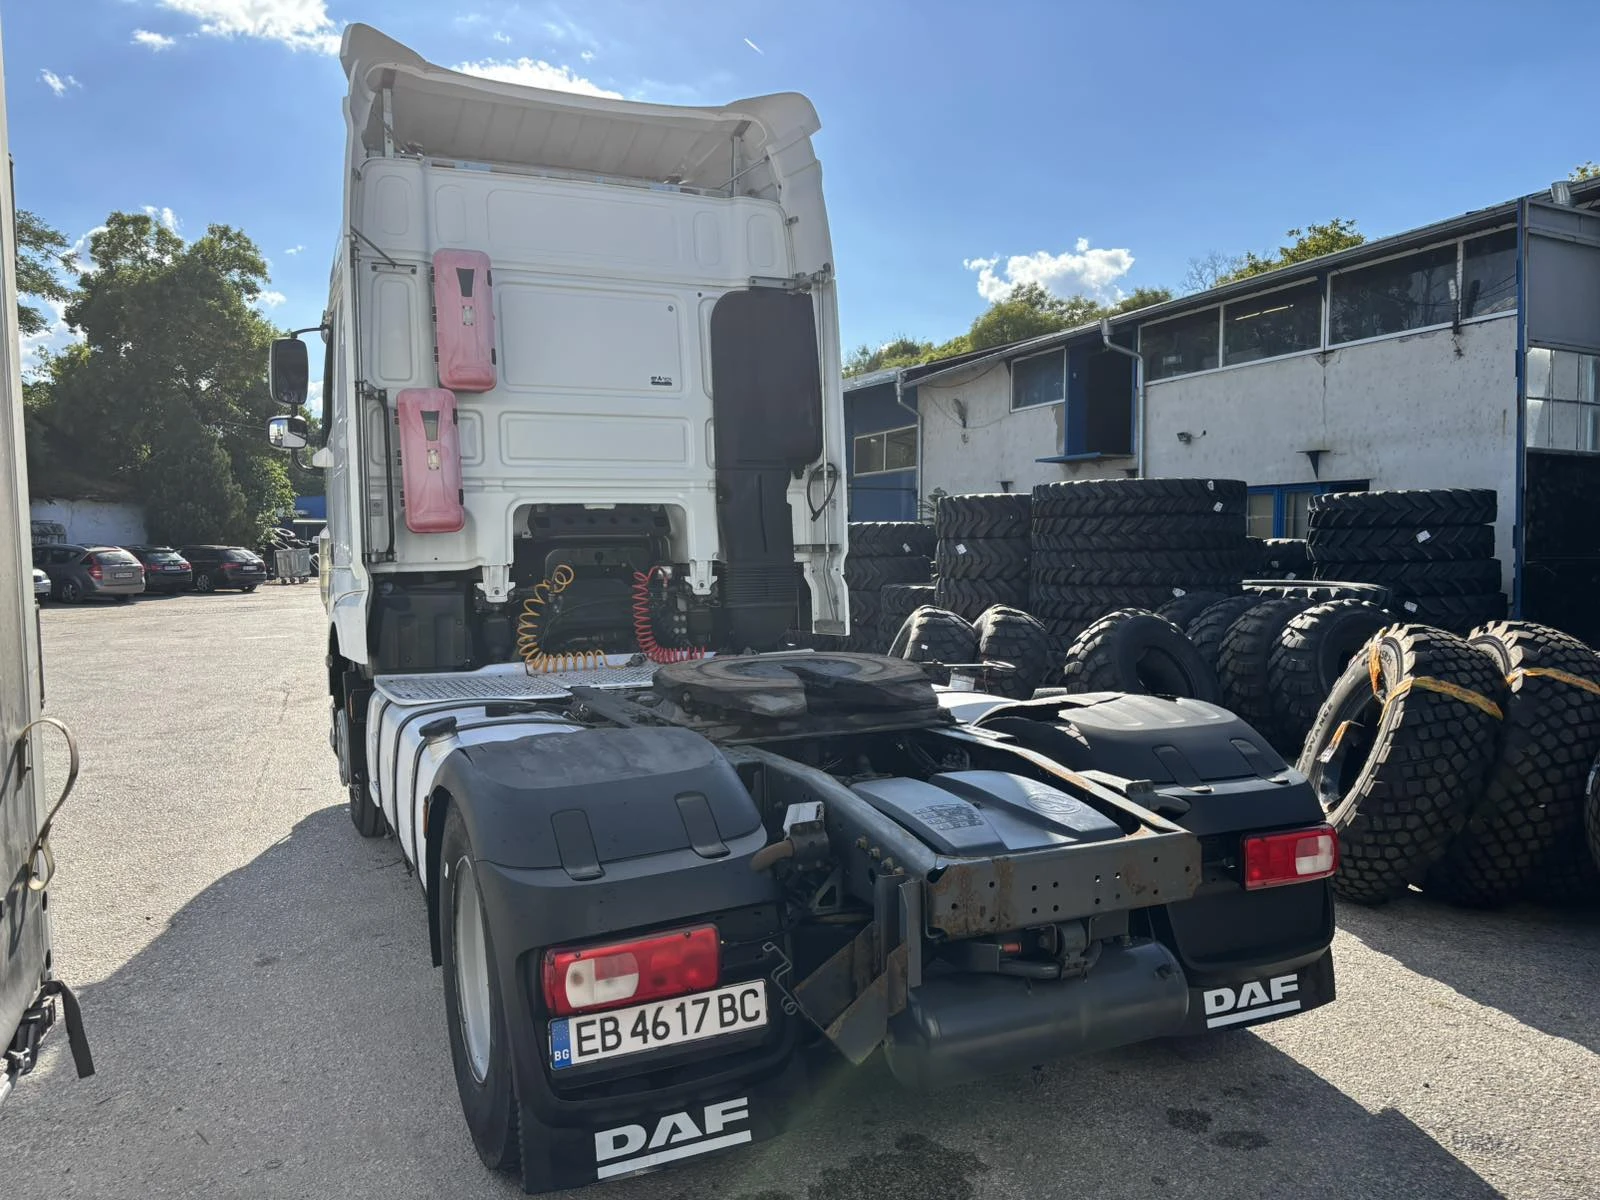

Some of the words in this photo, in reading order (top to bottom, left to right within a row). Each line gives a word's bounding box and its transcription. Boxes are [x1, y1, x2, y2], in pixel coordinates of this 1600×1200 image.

[1304, 703, 1333, 763] ADVANCE
[576, 1016, 622, 1057] EB
[630, 997, 710, 1044] 4617
[717, 988, 760, 1028] BC
[1203, 973, 1299, 1015] DAF
[554, 1049, 570, 1061] BG
[594, 1096, 749, 1161] DAF
